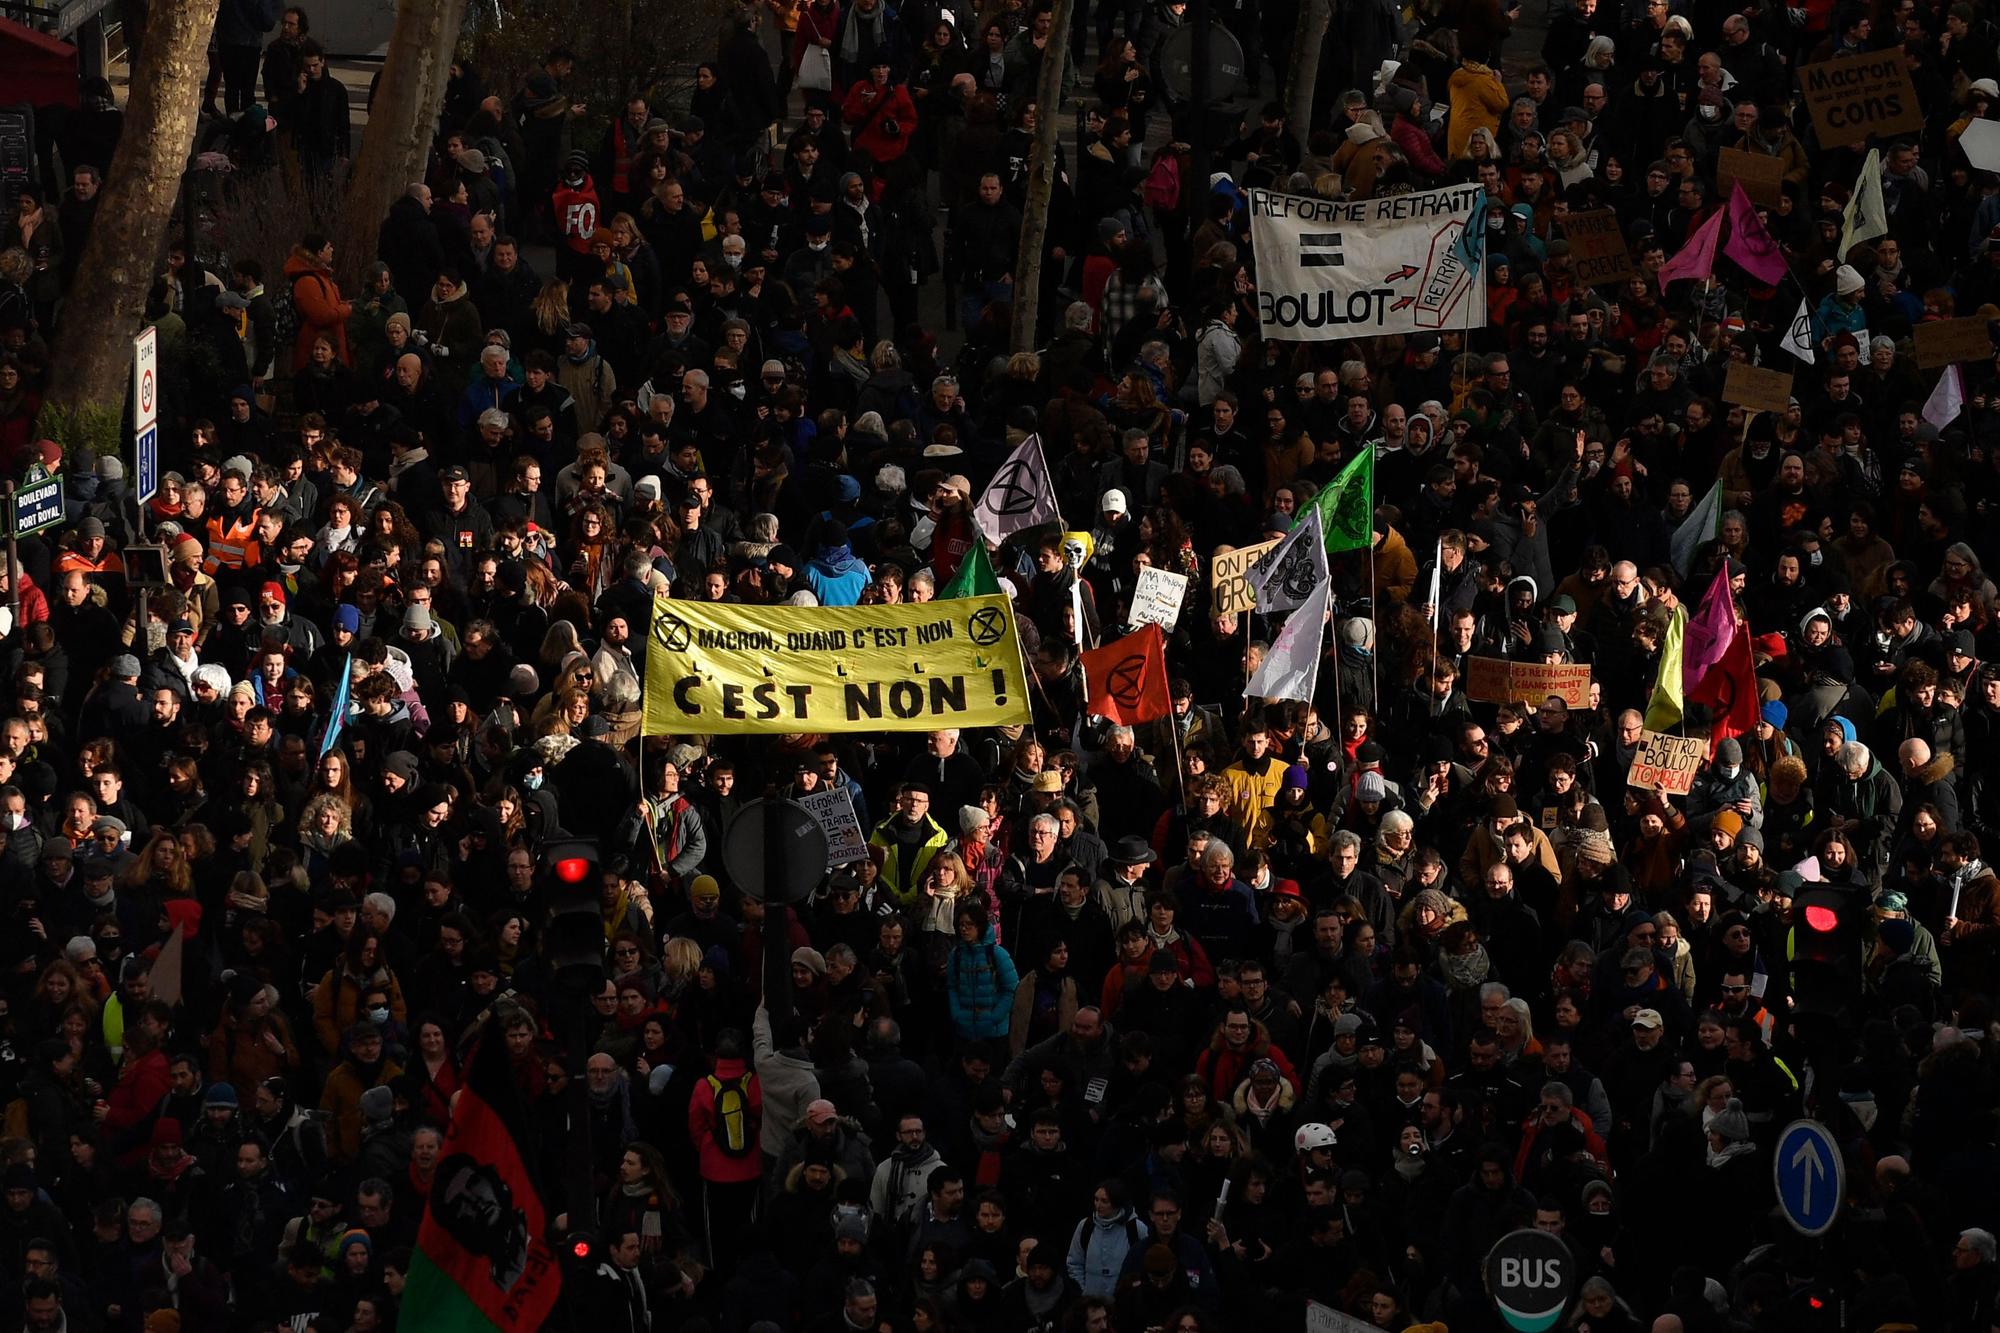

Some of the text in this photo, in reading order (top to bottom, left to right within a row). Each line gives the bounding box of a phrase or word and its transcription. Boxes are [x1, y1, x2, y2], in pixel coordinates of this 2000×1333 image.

[1808, 60, 1899, 91] Macron
[1826, 93, 1903, 128] cons
[1252, 189, 1366, 222] REFORME
[566, 202, 596, 240] FO
[1259, 289, 1394, 328] BOULOT
[141, 342, 153, 361] ZONE
[144, 382, 151, 399] 30
[18, 484, 57, 508] BOULEVARD
[19, 505, 60, 530] PORT ROYAL
[1142, 571, 1159, 582] MA
[1216, 555, 1240, 577] ON
[698, 620, 953, 652] MACRON, QUAND C'EST NON
[1514, 680, 1582, 690] CHANGEMENT
[674, 675, 812, 719] C'EST
[844, 676, 966, 721] NON
[1651, 735, 1697, 755] METRO
[1644, 748, 1698, 772] BOULOT
[1634, 764, 1693, 792] TOMBEAU
[804, 791, 845, 811] RÉFORME
[821, 807, 833, 818] DES
[1501, 1257, 1561, 1288] BUS
